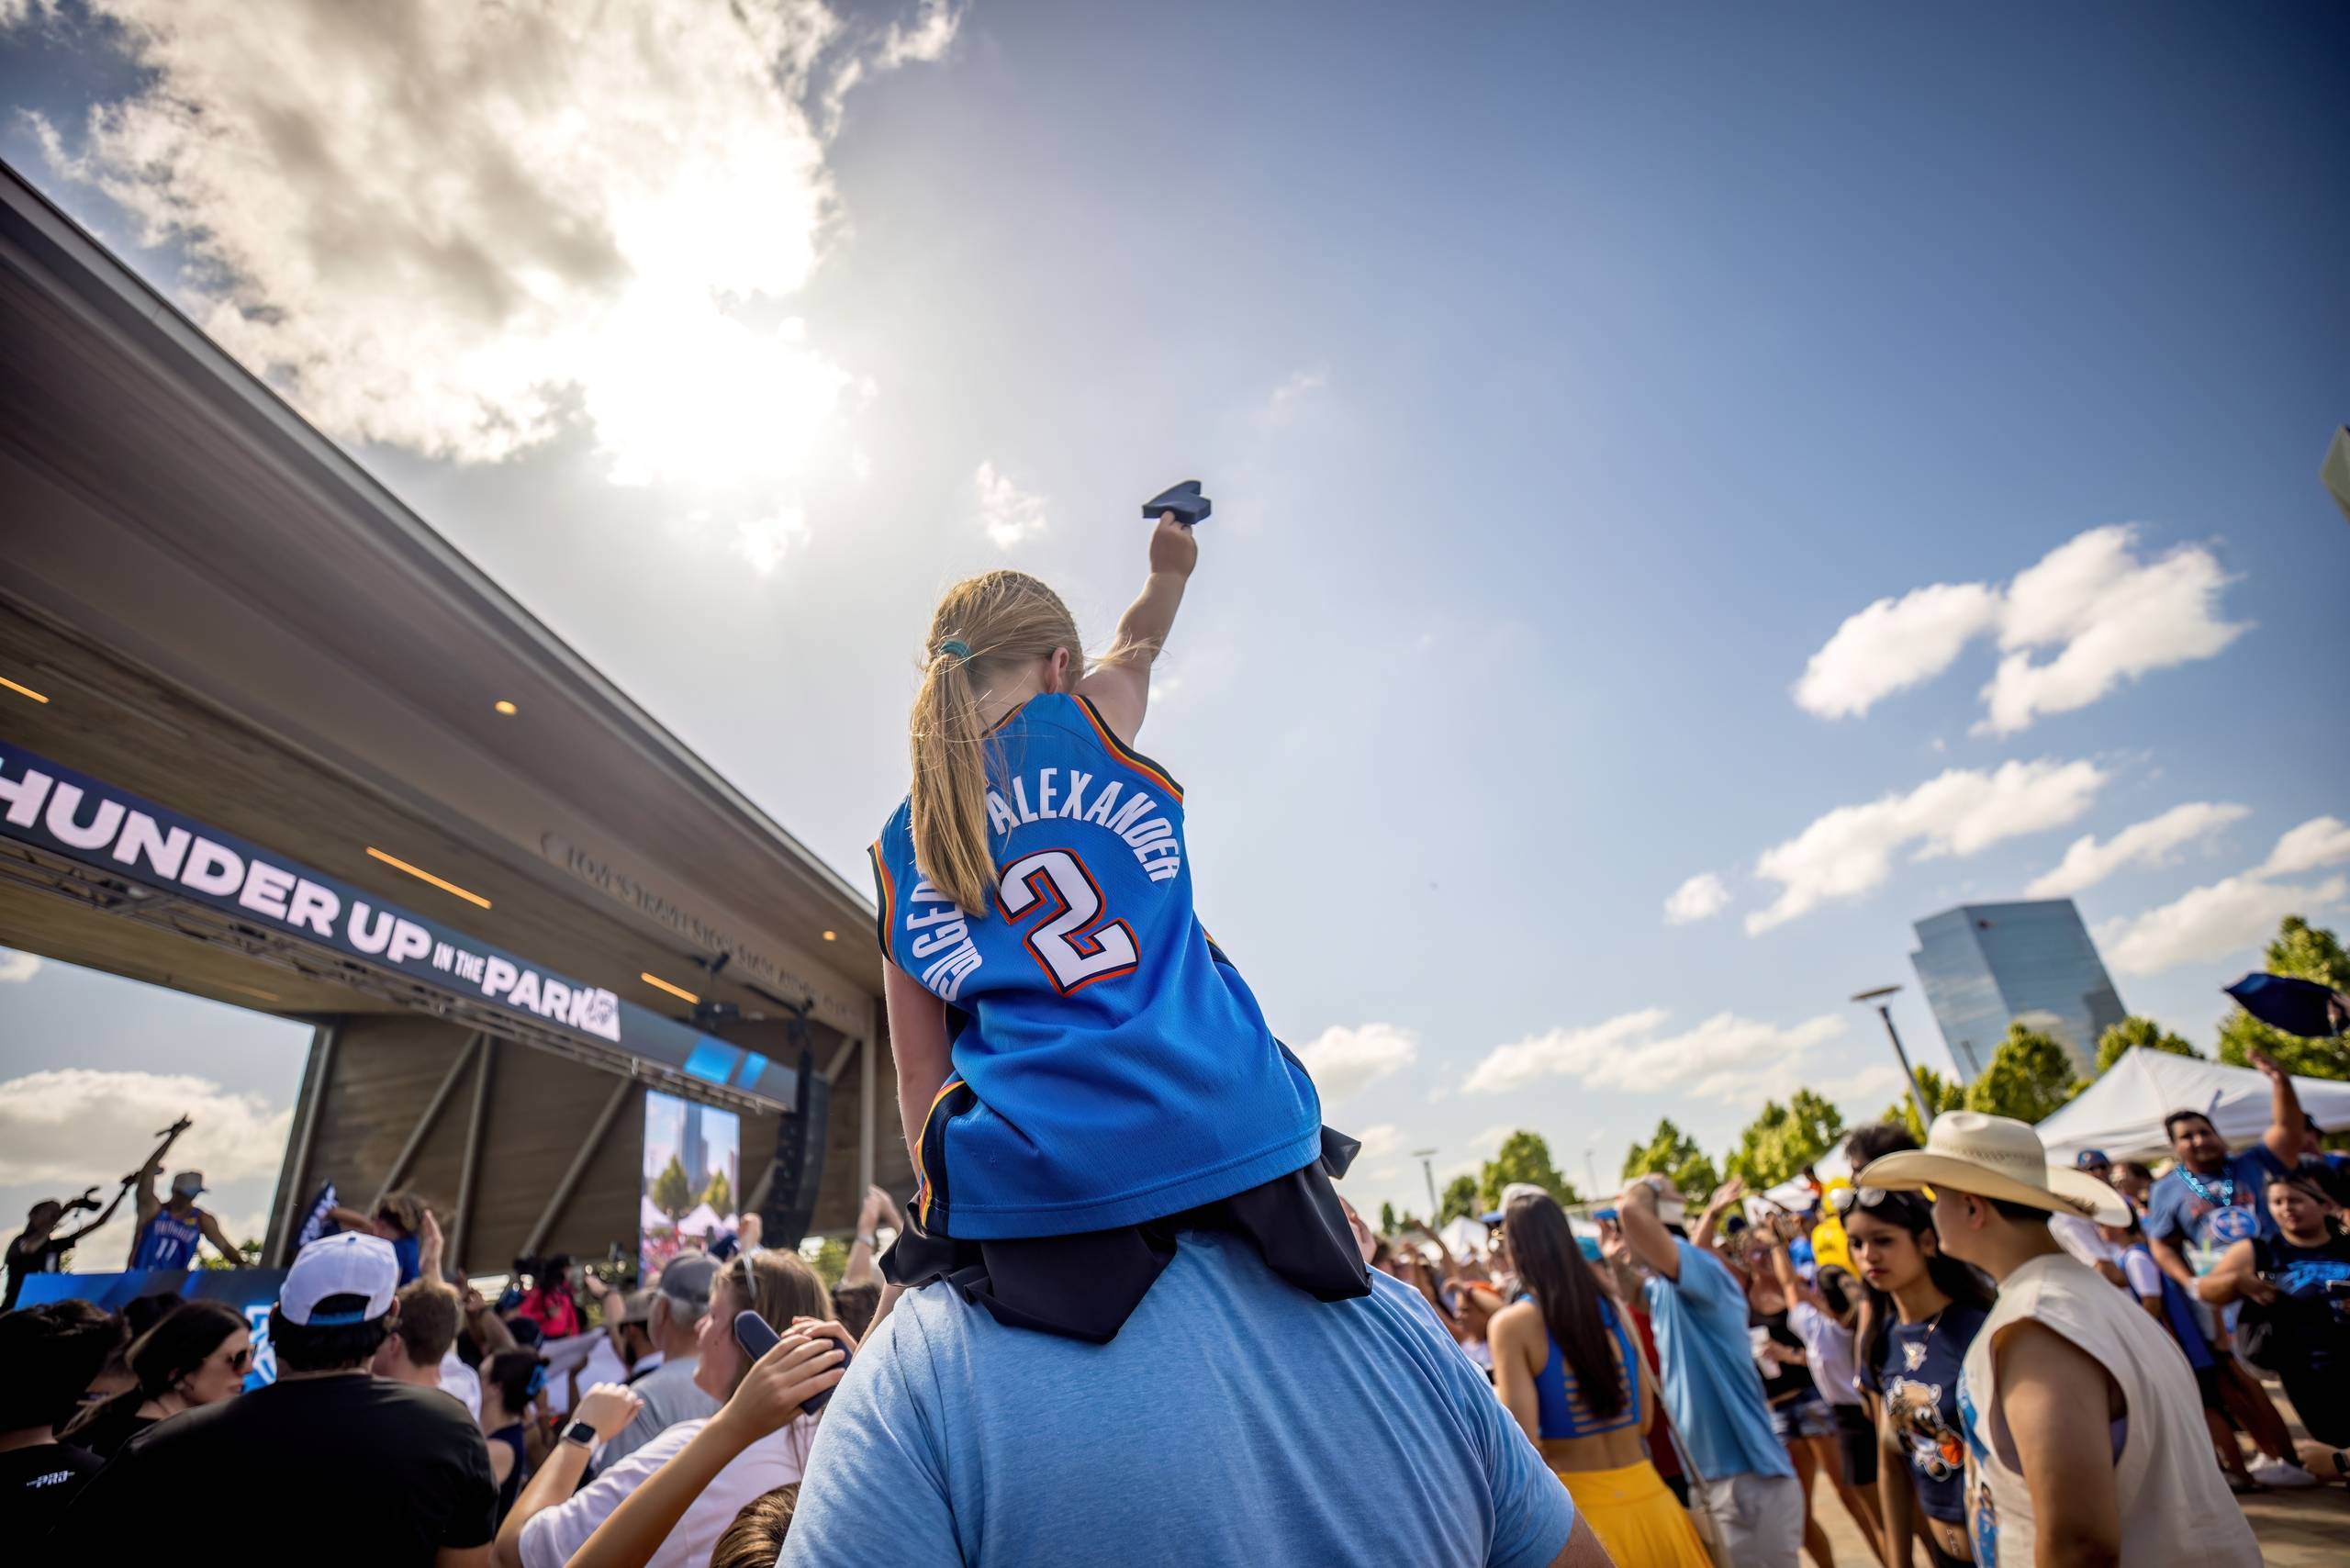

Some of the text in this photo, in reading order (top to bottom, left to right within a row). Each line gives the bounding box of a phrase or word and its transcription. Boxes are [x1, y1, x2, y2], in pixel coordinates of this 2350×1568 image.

[347, 900, 432, 964] UP
[432, 942, 455, 972] IN
[455, 949, 487, 984] THE
[481, 955, 598, 1029] PARK
[994, 848, 1141, 998] 2
